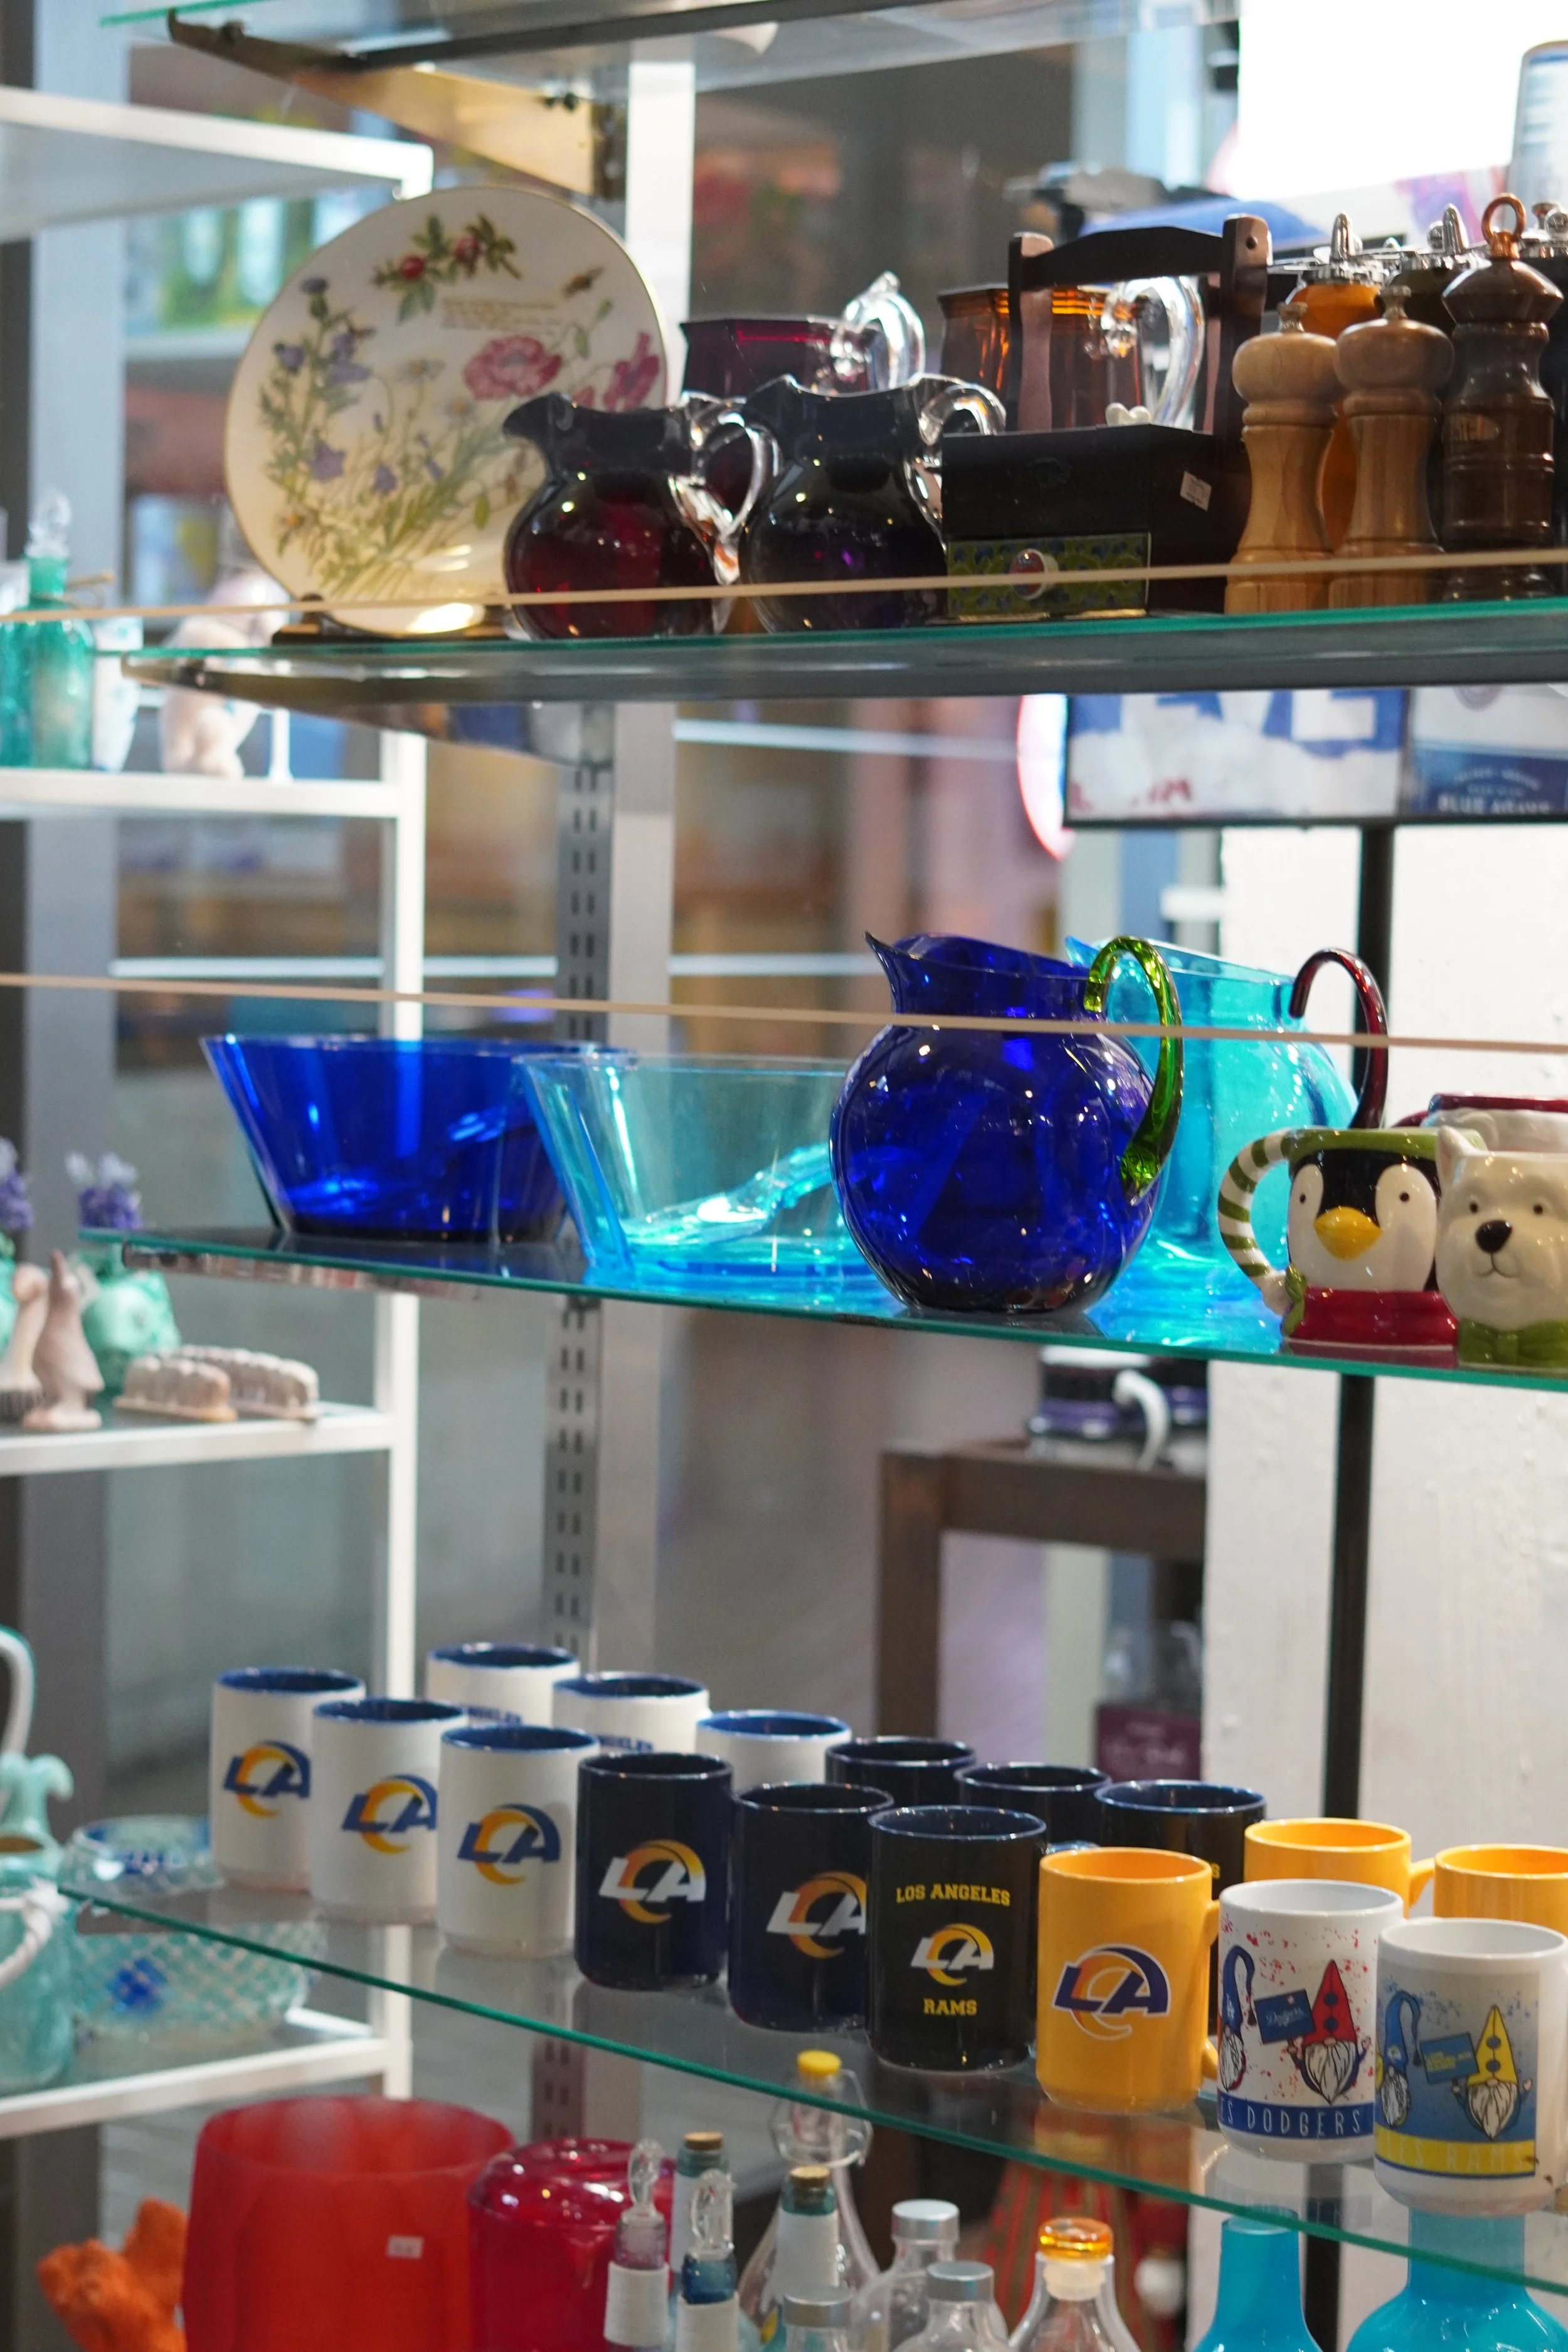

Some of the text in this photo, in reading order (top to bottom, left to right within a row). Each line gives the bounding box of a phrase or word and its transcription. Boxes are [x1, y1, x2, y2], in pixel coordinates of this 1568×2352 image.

[223, 1740, 310, 1798] LA
[341, 1774, 440, 1833] LA
[457, 1803, 561, 1863] LA
[598, 1840, 706, 1903] LA
[896, 1883, 1011, 1907] LOS ANGELES
[766, 1872, 868, 1937] LA
[910, 1923, 994, 1971] LA
[923, 1998, 978, 2017] RAMS
[1052, 1943, 1172, 2018] LA
[1247, 2106, 1360, 2136] DODGERS
